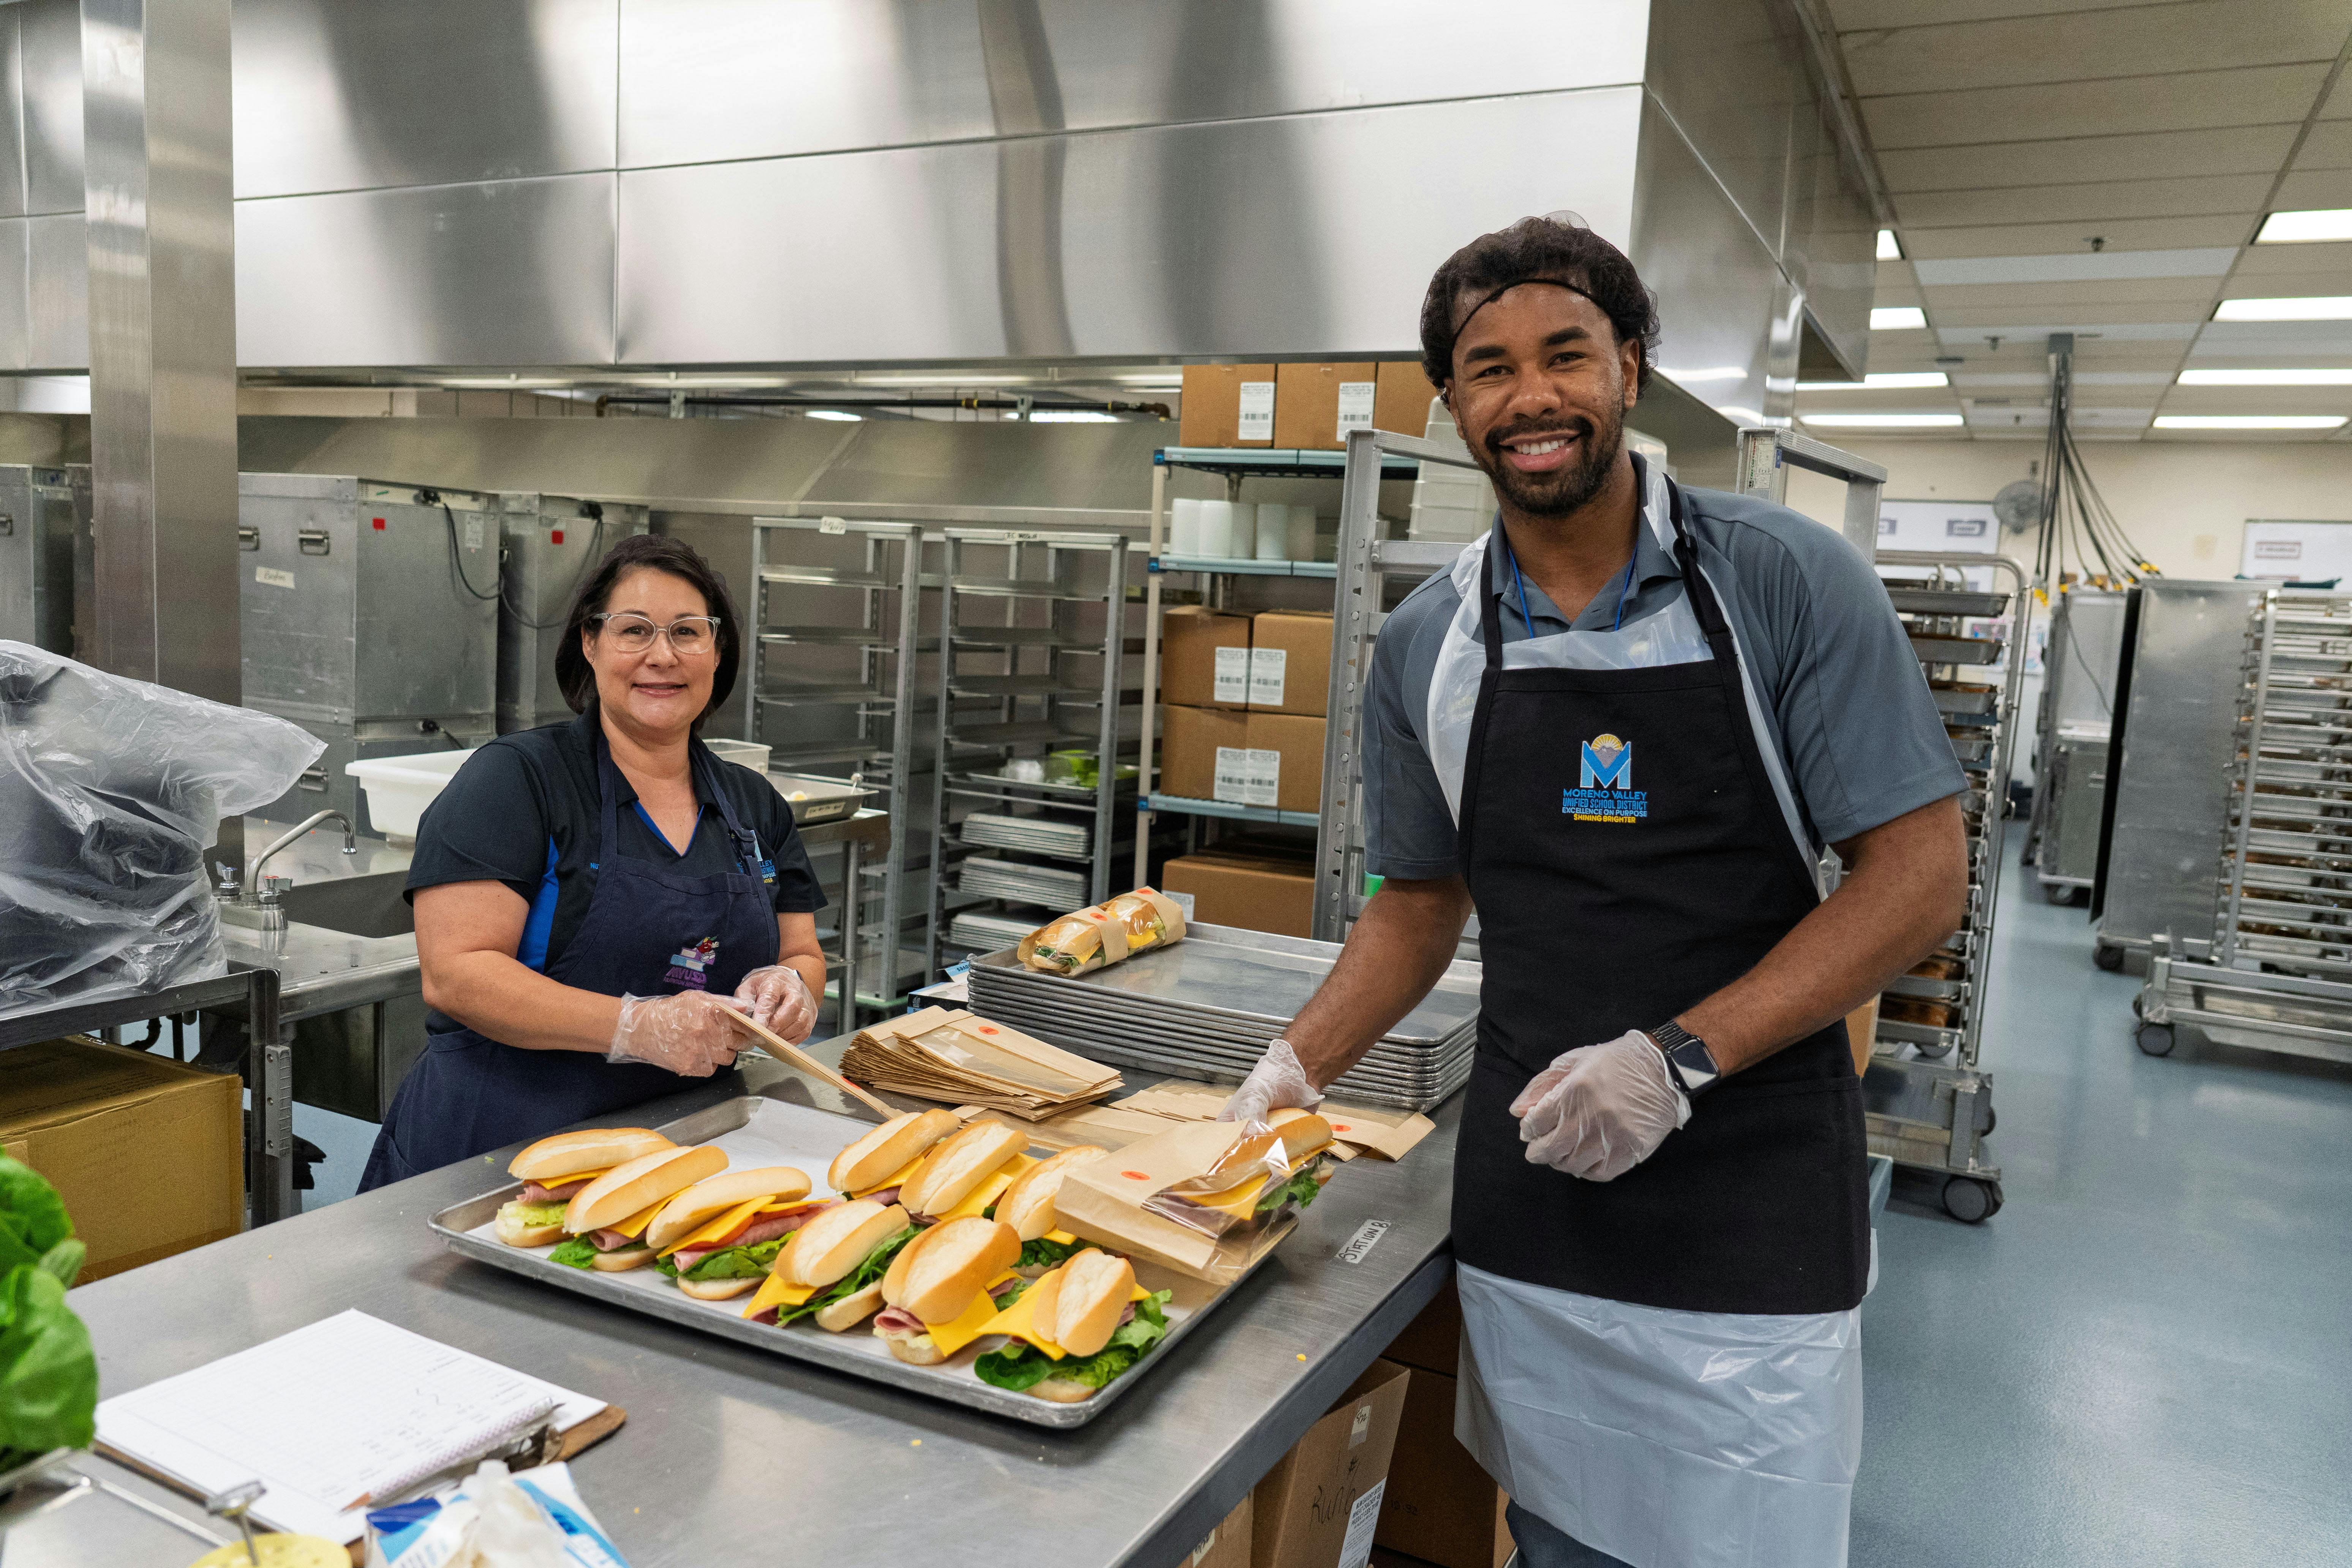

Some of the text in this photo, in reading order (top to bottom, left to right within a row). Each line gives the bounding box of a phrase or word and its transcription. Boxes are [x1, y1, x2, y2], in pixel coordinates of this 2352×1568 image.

[1563, 789, 1647, 800] MORENO VALLEY
[1563, 798, 1647, 810] UNIFIED SCHOOL DISTRICT
[1573, 813, 1602, 822] SHINING
[1338, 1228, 1380, 1260] STATION
